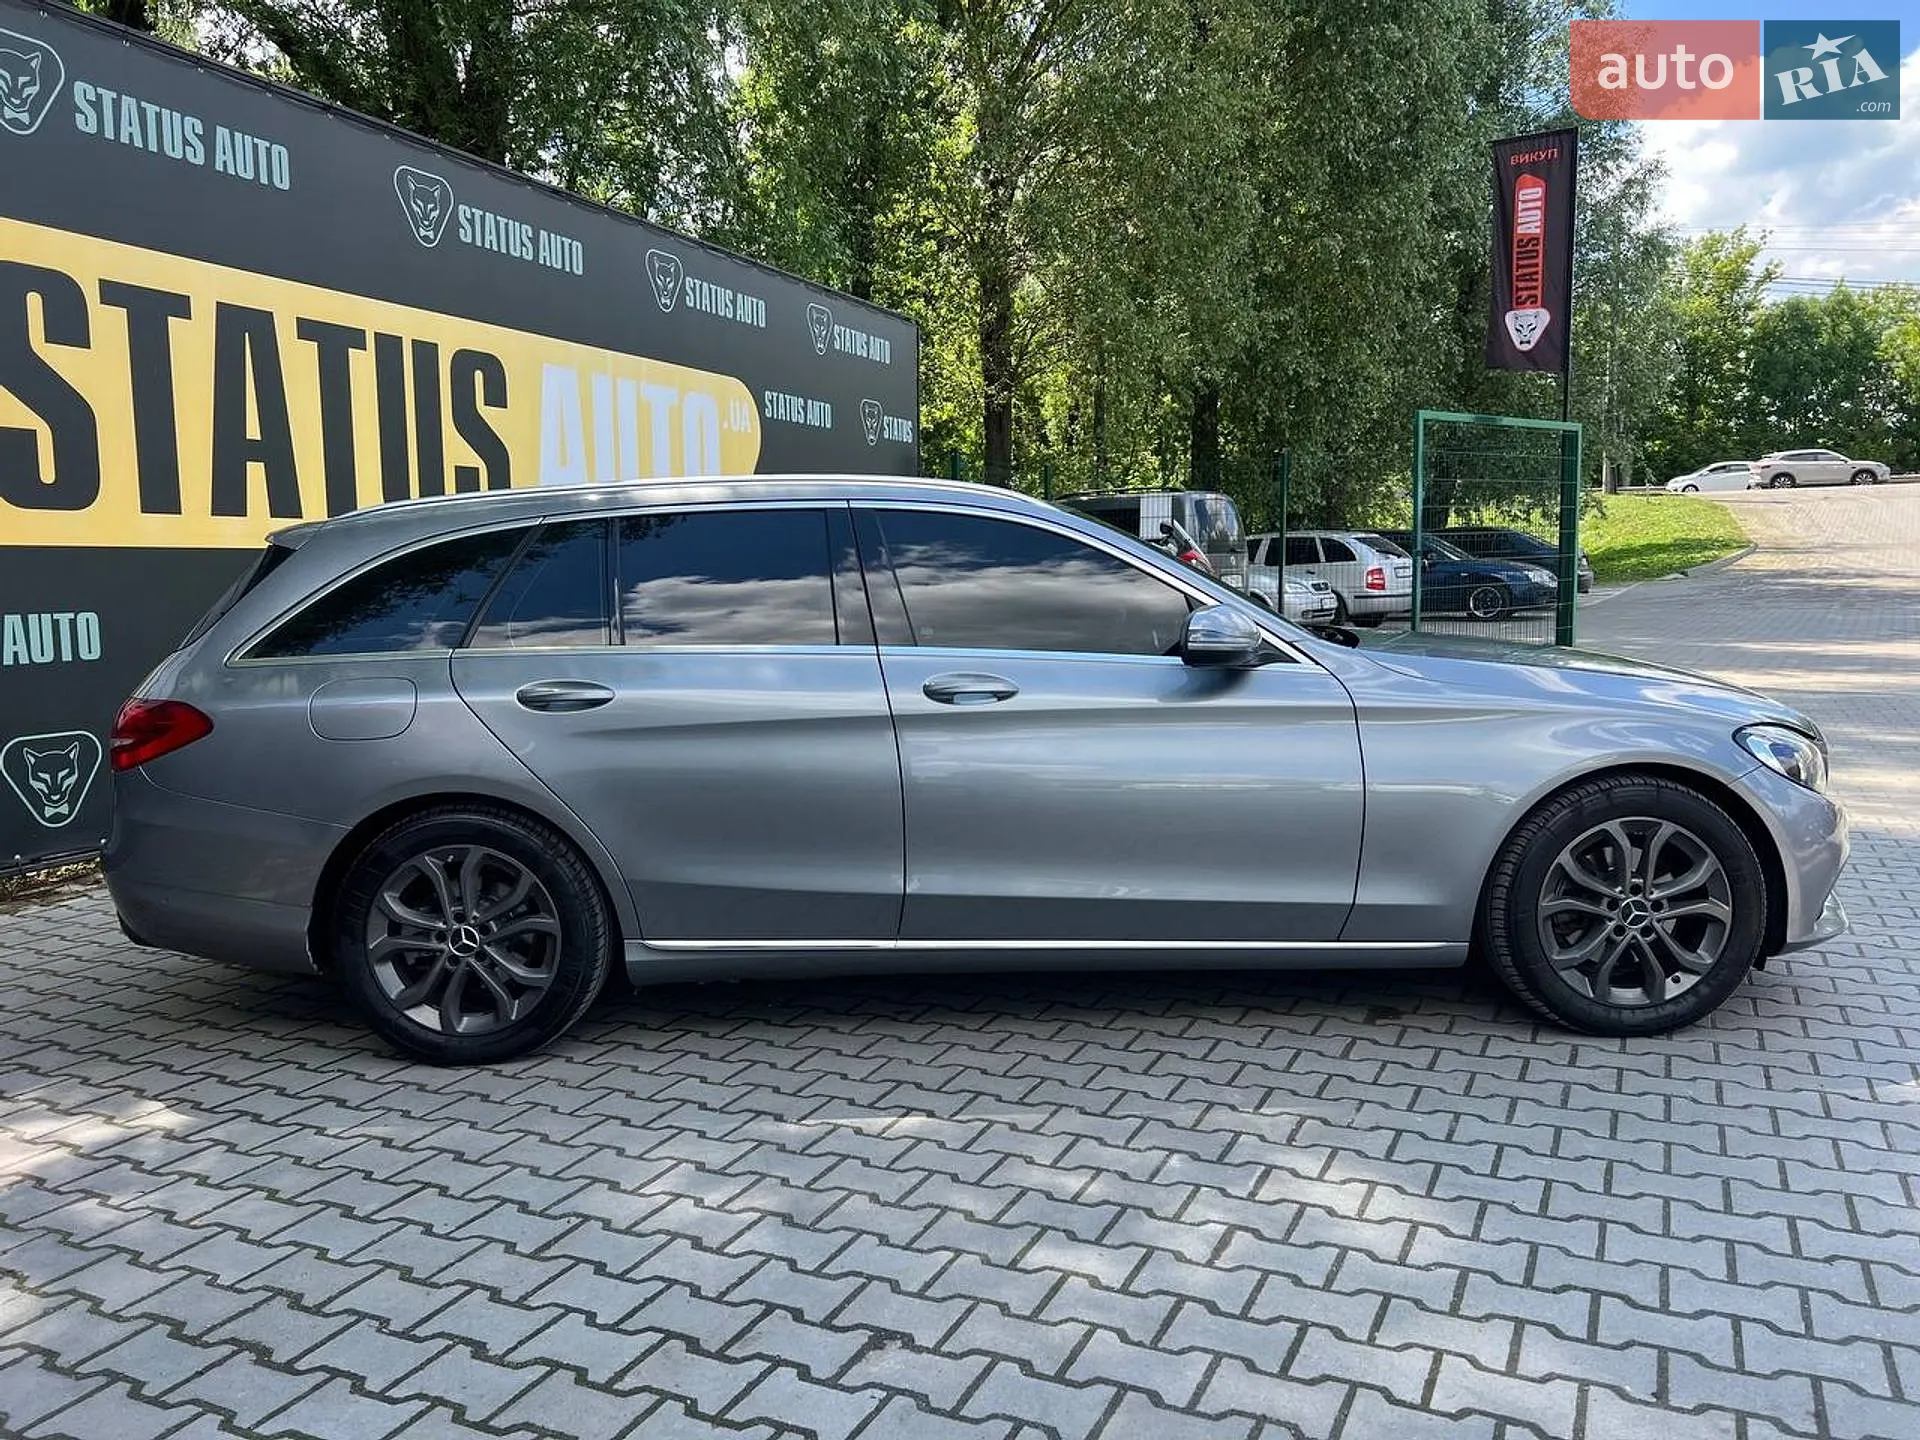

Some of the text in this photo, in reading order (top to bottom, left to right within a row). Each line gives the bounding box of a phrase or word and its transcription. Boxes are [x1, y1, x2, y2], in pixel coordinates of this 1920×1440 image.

[73, 80, 290, 191] STATUS AUTO
[1511, 148, 1558, 166] ВИКУП
[457, 203, 584, 275] STATUS AUTO
[1515, 187, 1541, 306] STATUS AUTO
[685, 276, 766, 328] STATUS AUTO
[833, 324, 891, 364] STATUS AUTO
[0, 259, 512, 518] STATUS
[540, 362, 720, 486] AUTO
[764, 390, 832, 429] STATUS AUTO
[883, 415, 913, 443] STATUS
[3, 612, 101, 666] AUTO
